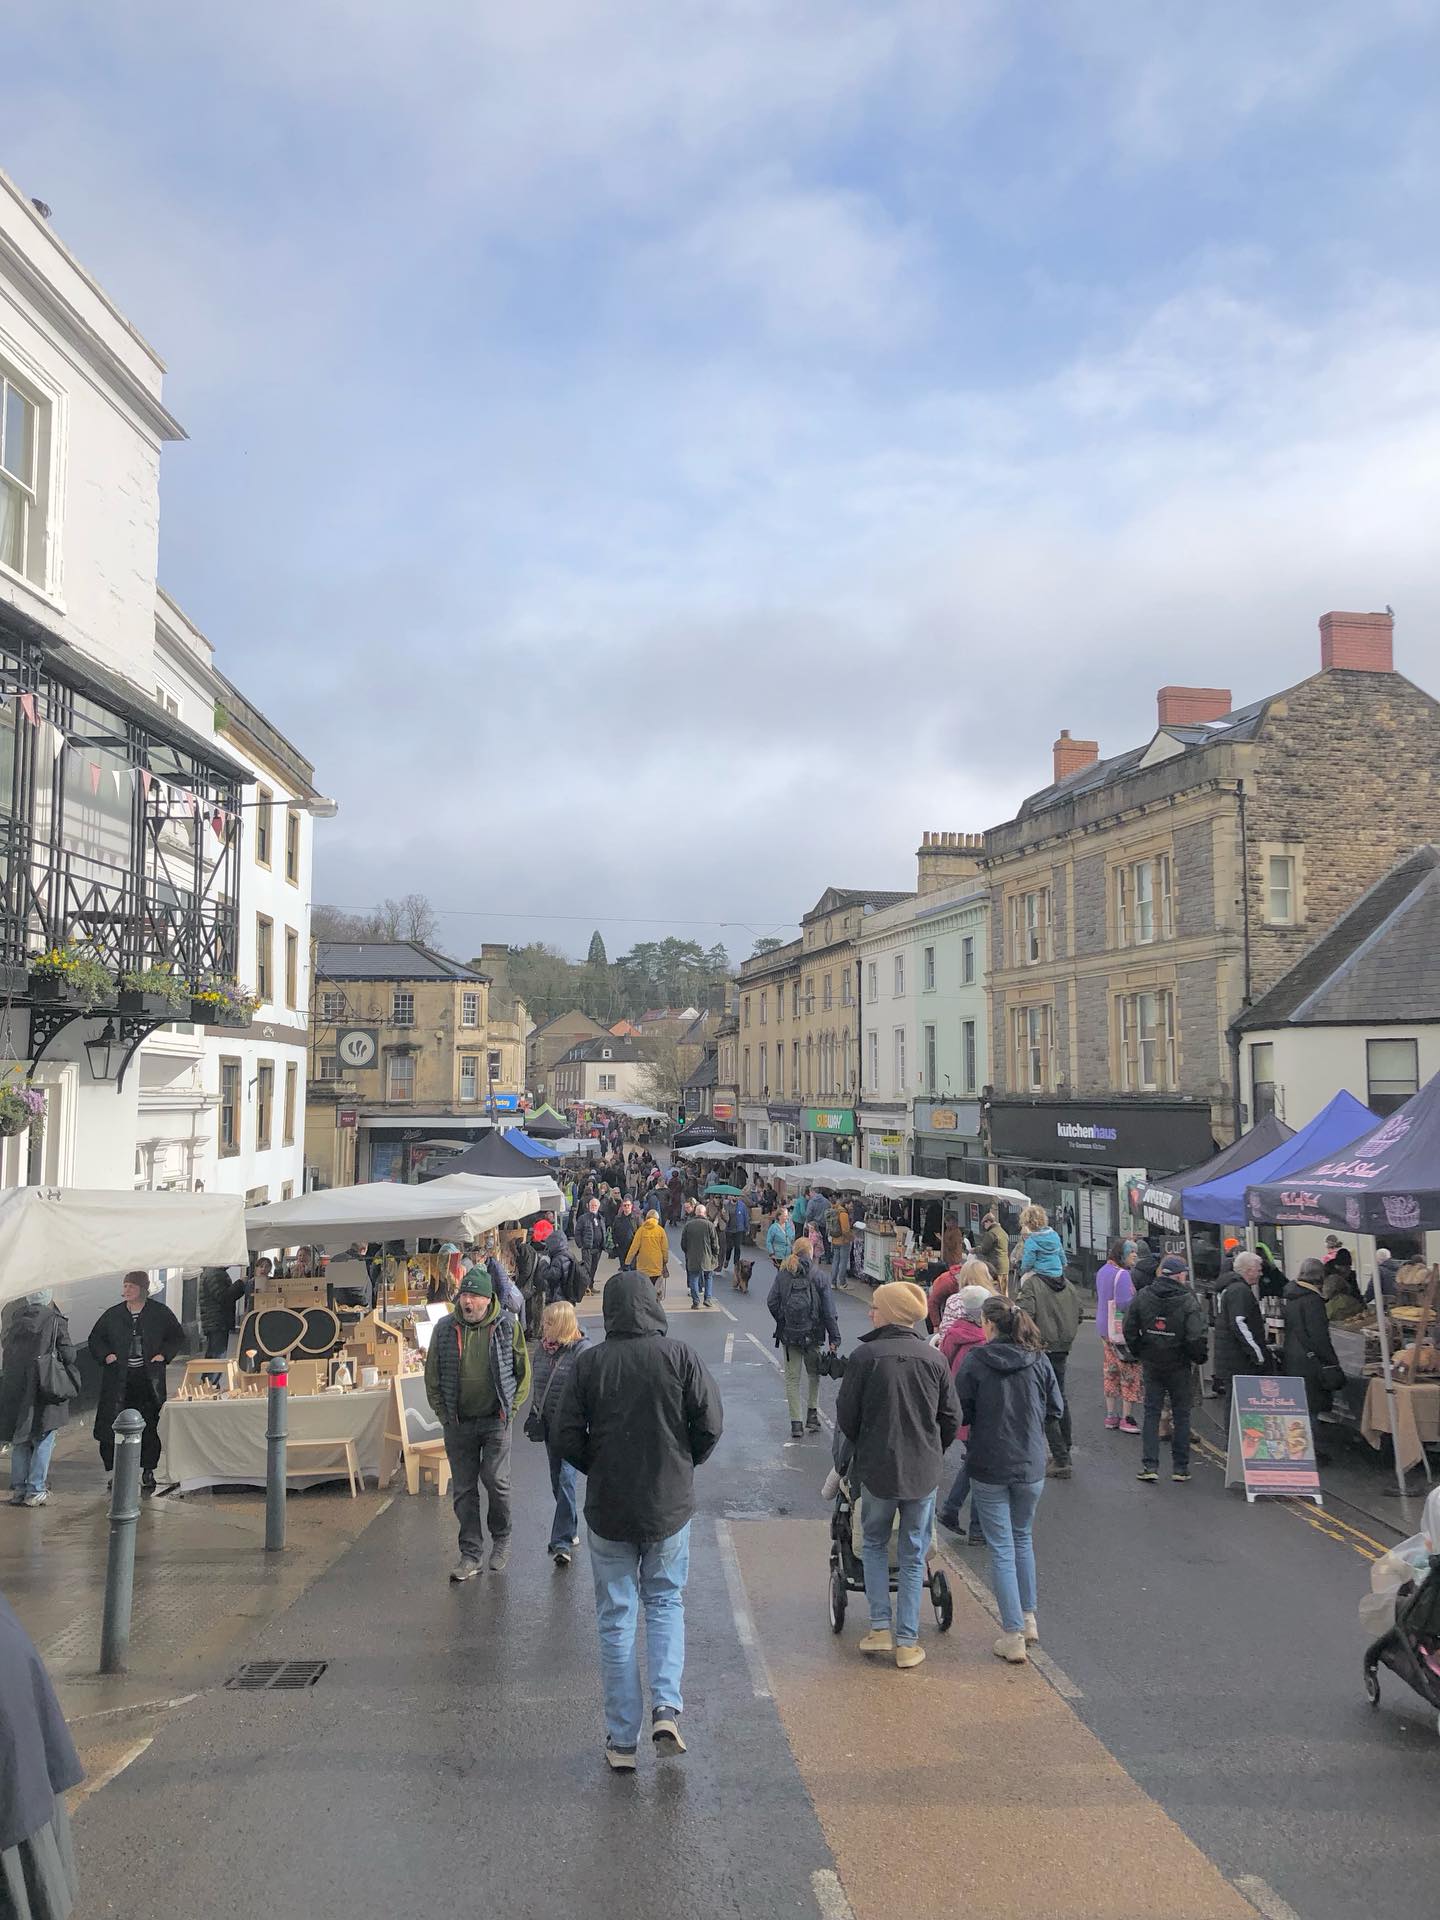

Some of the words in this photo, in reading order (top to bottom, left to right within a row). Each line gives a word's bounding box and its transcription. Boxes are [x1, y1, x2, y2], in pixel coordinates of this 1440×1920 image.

[816, 1113, 842, 1129] SUBWAY
[1165, 1241, 1186, 1254] CUP
[1248, 1398, 1259, 1406] The
[1259, 1397, 1275, 1407] Loaf
[1276, 1398, 1296, 1406] Shack
